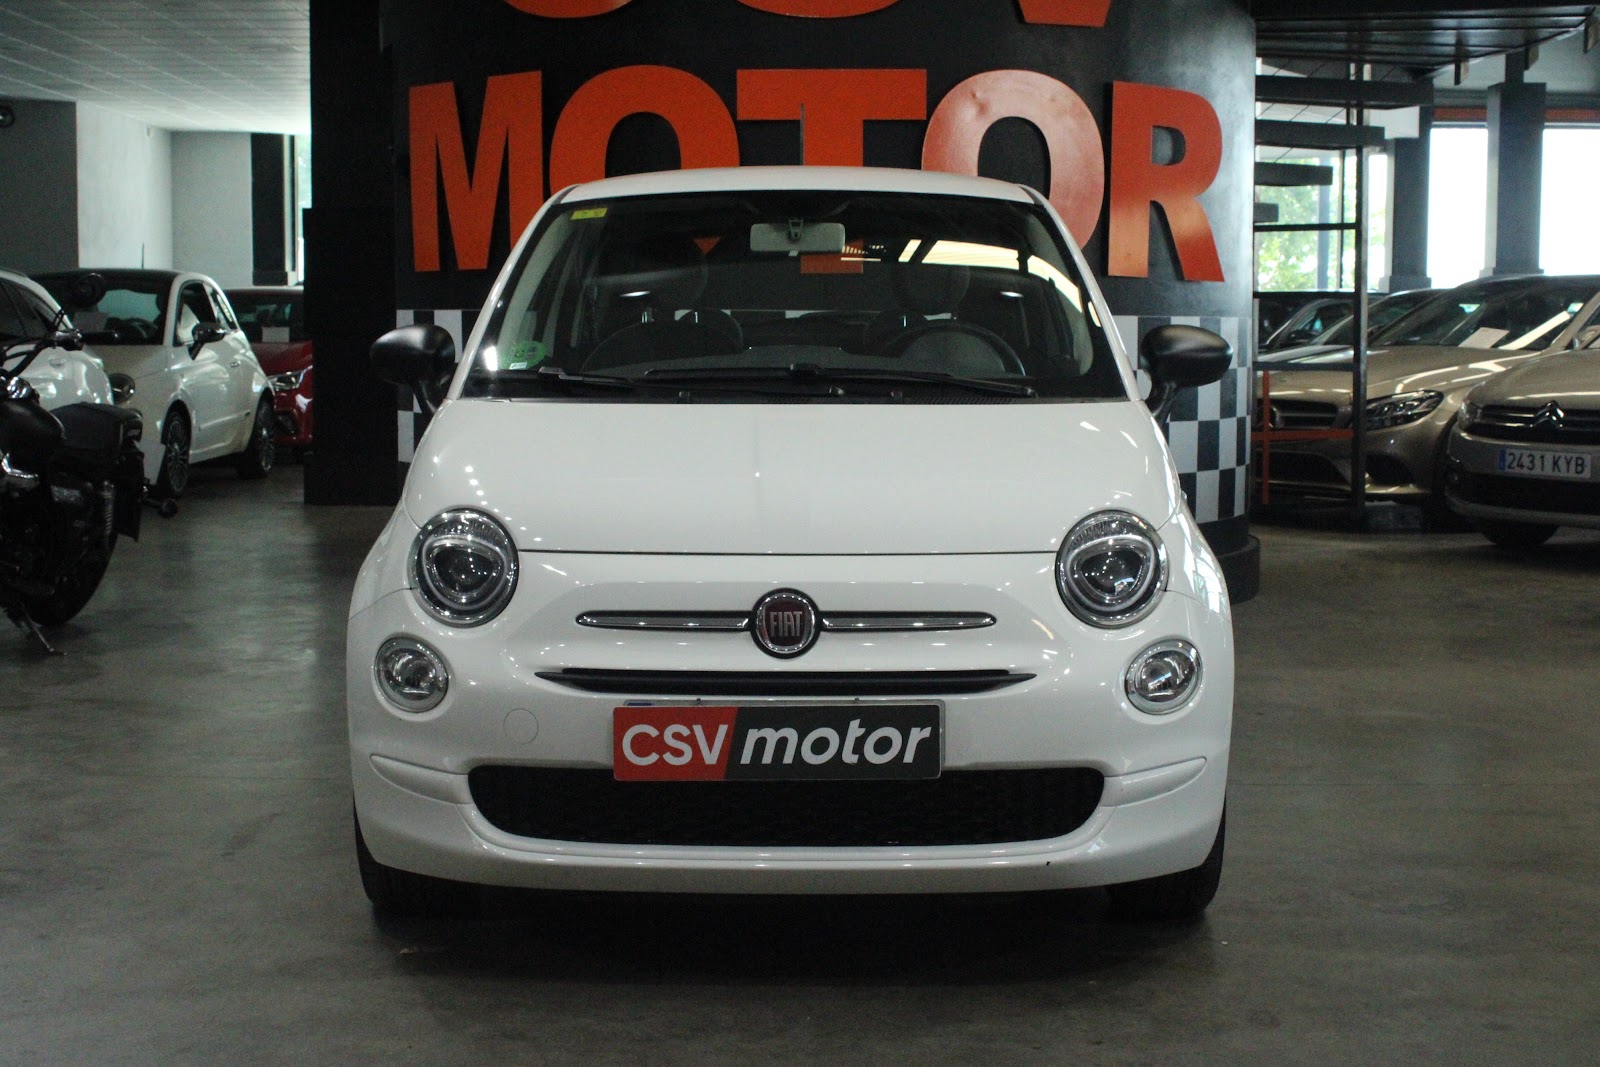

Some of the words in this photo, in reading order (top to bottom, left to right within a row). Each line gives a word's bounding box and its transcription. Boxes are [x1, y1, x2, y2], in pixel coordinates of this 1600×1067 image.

[408, 65, 1223, 282] MOTOR
[1507, 452, 1545, 472] 2431
[1552, 455, 1585, 475] KYB
[769, 611, 803, 637] FIAT
[622, 723, 729, 766] CSV
[740, 718, 932, 765] motor
